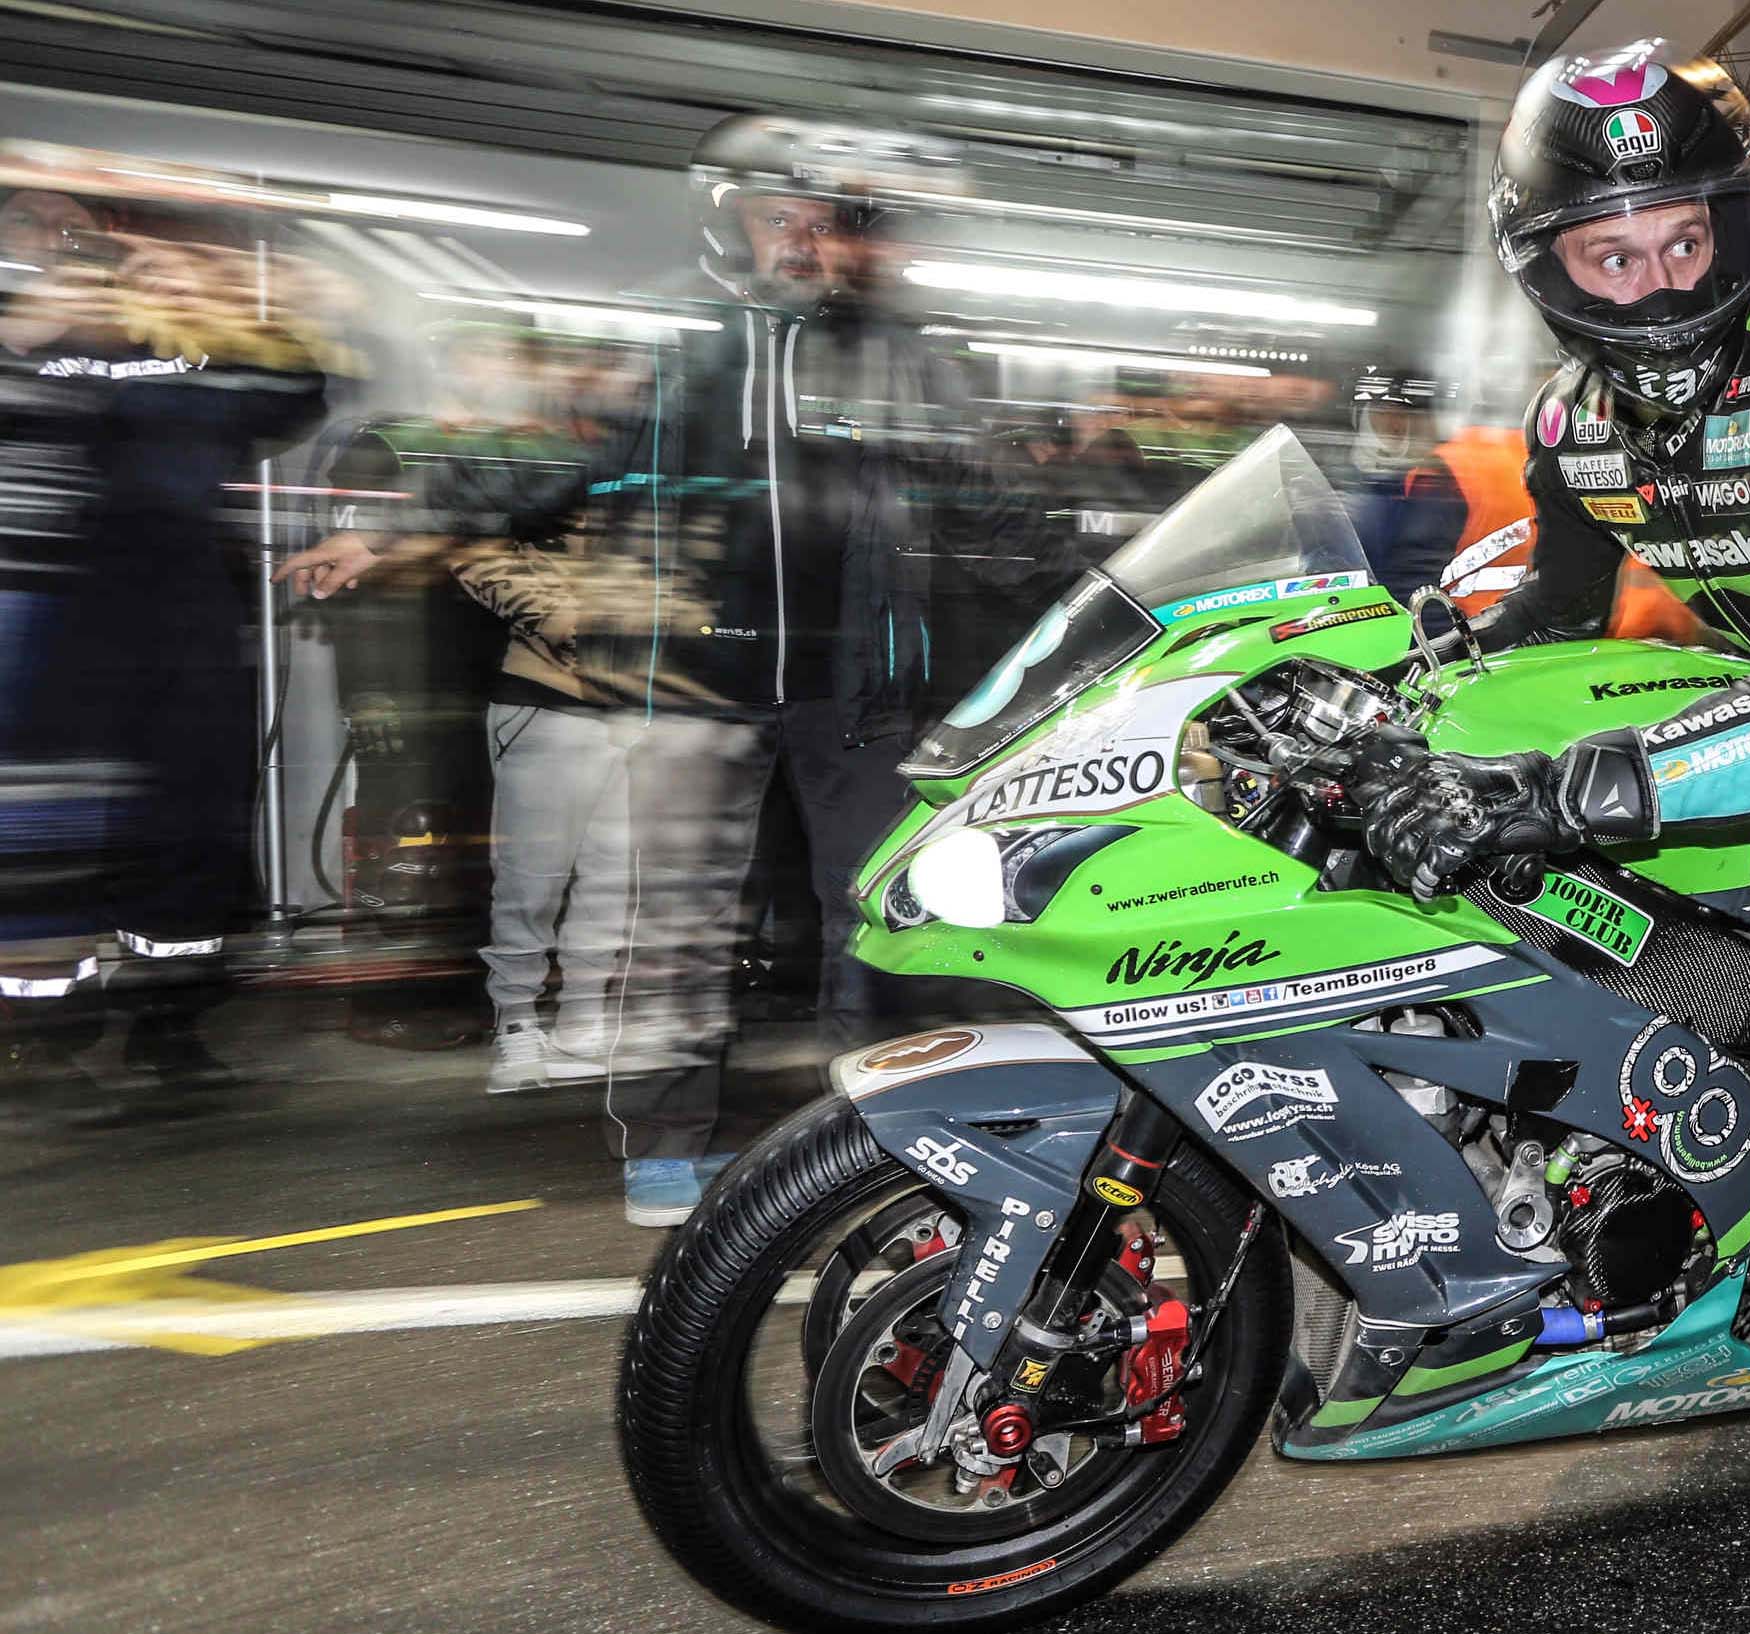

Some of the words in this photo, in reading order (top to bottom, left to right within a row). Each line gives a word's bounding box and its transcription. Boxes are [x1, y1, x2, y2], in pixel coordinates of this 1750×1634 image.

[1616, 133, 1655, 153] agv
[1578, 422, 1607, 441] agv
[1563, 468, 1624, 488] LATTESSO
[1695, 481, 1750, 508] WAGO
[1195, 587, 1274, 612] MOTOREX
[1589, 673, 1746, 700] Kawasak
[964, 750, 1165, 825] LATTESSO
[1107, 870, 1280, 912] www.zweiradberufe.ch
[1547, 876, 1626, 927] 100ER
[1565, 908, 1633, 954] CLUB
[1106, 929, 1281, 990] Ninja
[1104, 1003, 1169, 1025] follow
[1176, 997, 1208, 1016] us!
[1283, 958, 1437, 1000] /TeamBolliger8
[1206, 1067, 1256, 1108] LOGO
[1261, 1068, 1320, 1089] LYSS
[905, 1136, 978, 1186] sbs
[953, 1196, 1031, 1341] PIRELLI
